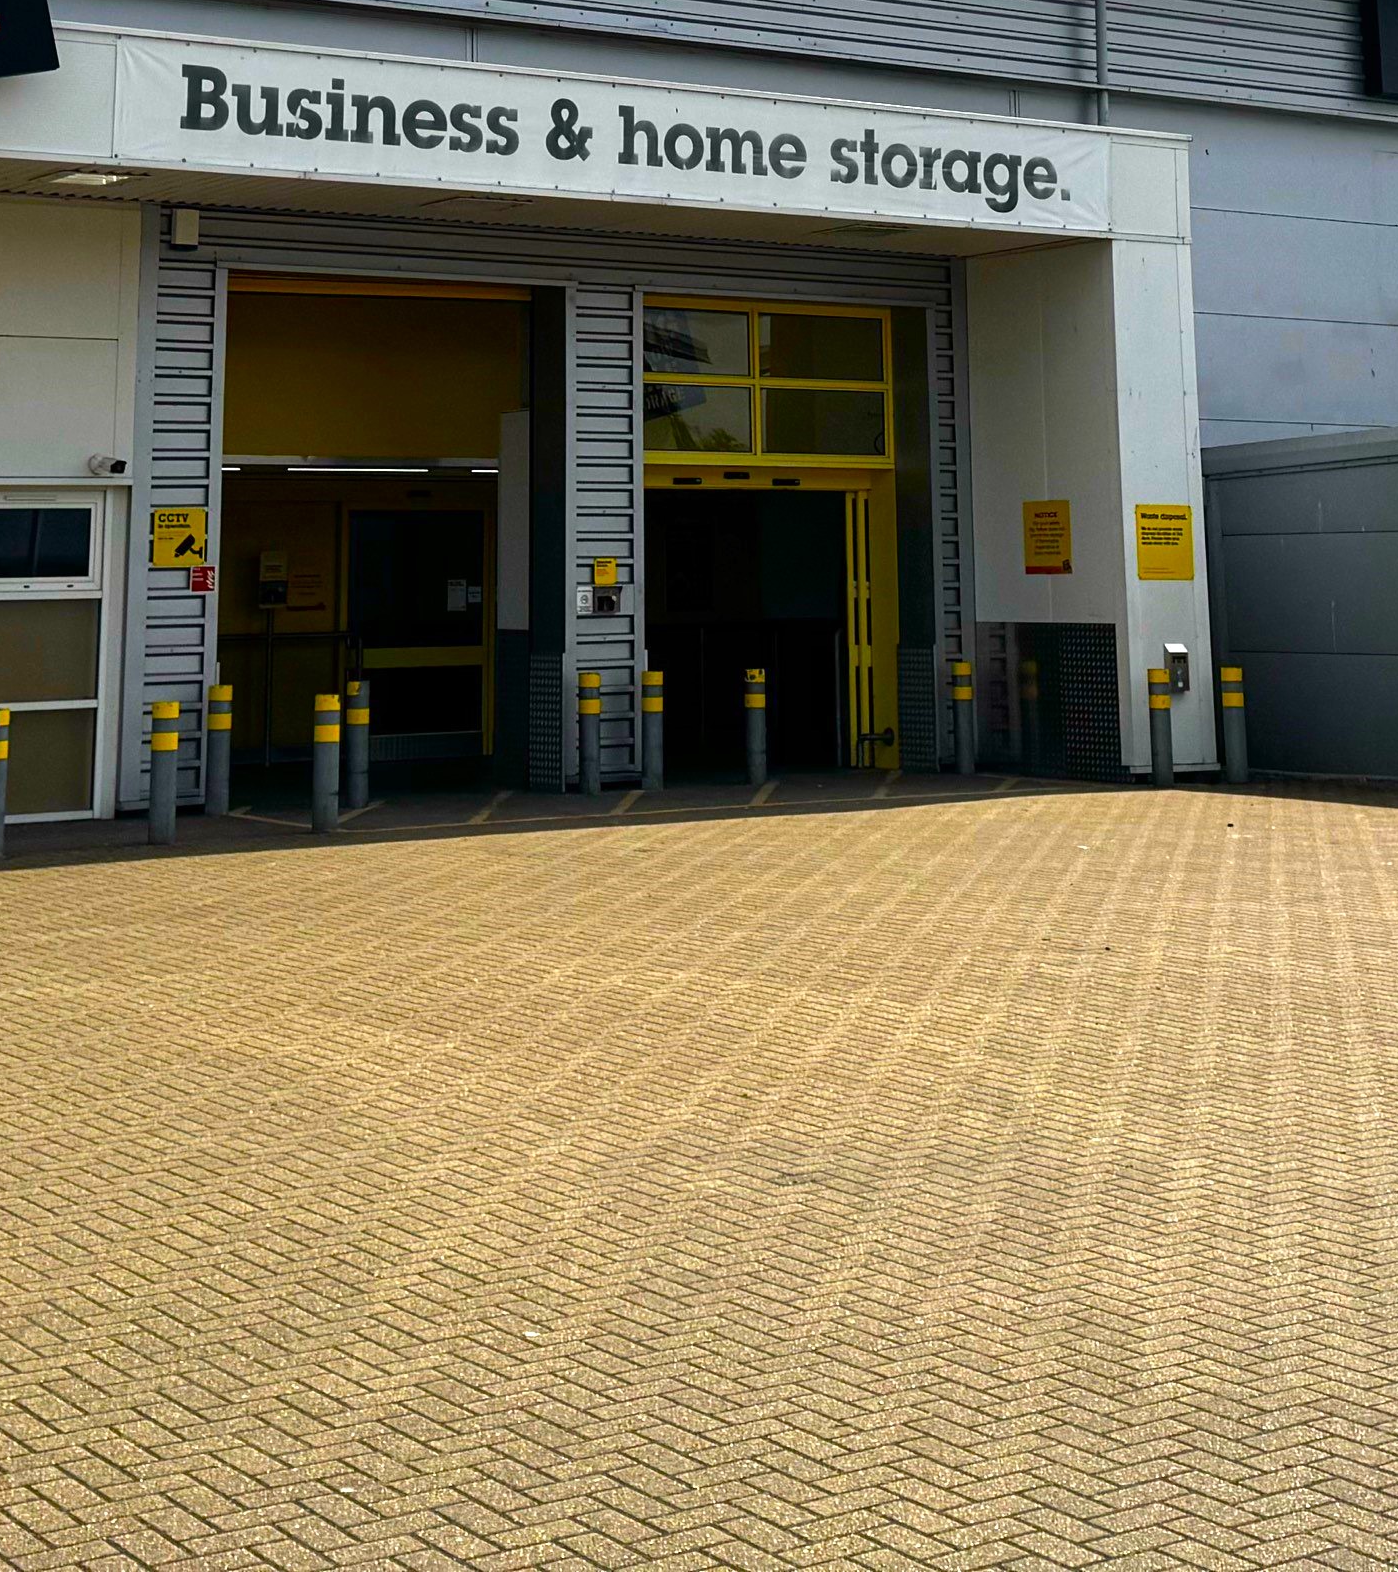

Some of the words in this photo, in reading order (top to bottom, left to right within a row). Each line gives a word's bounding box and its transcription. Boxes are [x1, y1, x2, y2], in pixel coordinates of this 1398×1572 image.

[179, 63, 520, 156] Business
[545, 98, 593, 161] &
[617, 105, 807, 179] home
[829, 129, 1071, 213] storage.
[158, 513, 189, 523] CCTV
